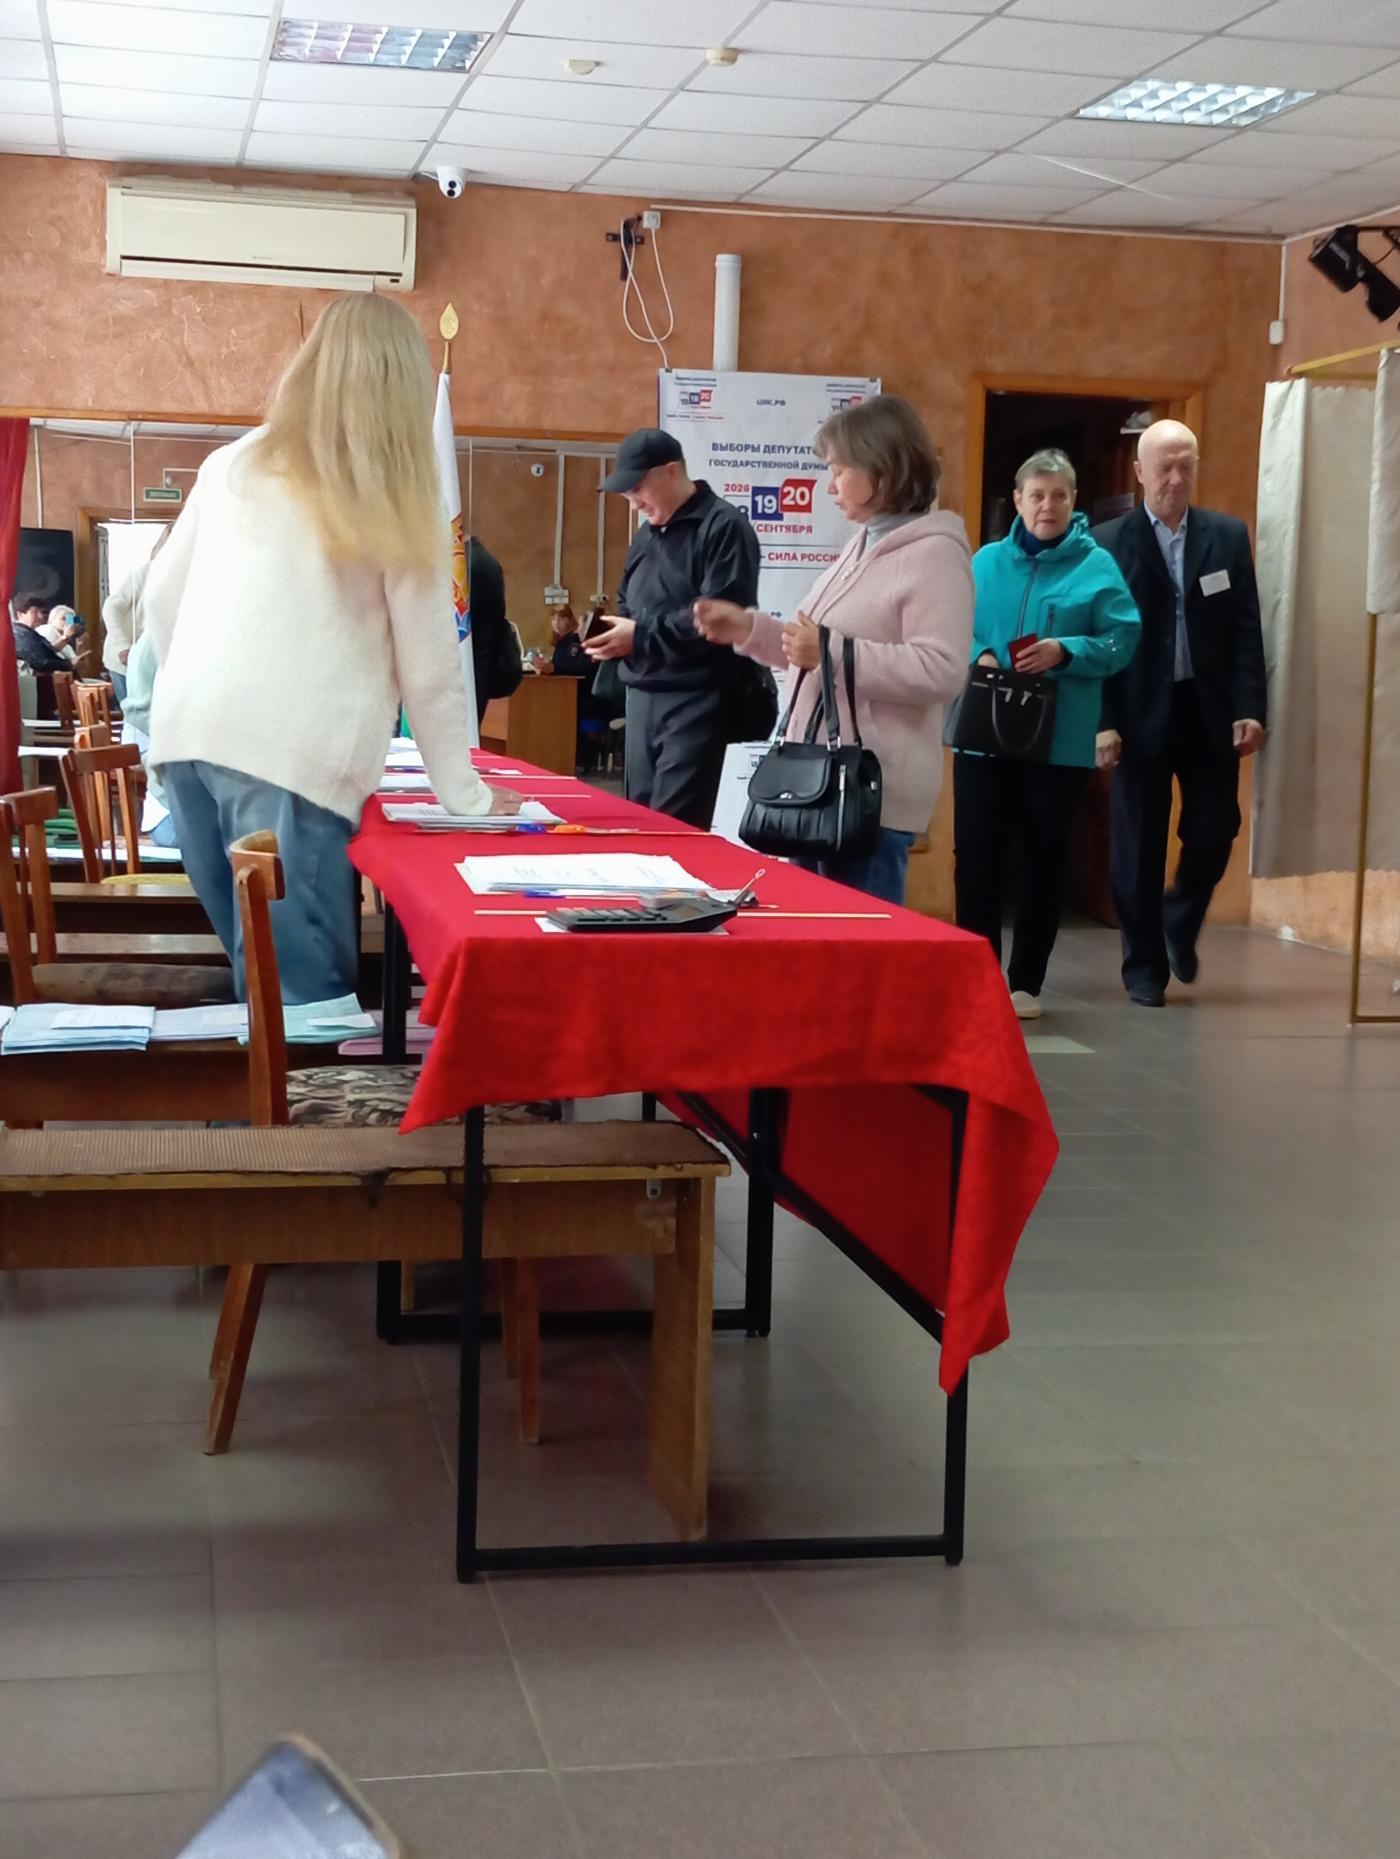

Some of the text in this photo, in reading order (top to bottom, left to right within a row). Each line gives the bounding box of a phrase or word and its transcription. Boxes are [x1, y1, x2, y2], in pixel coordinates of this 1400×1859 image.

[711, 442, 813, 455] ВЫБОРЫ ДЕПУТАТ
[709, 458, 829, 471] ГОСУДАРСТВЕННОЙ ДУМЫ
[724, 483, 750, 493] 2026
[754, 494, 778, 514] 19
[782, 486, 810, 506] 20
[756, 523, 813, 534] СЕНТЯБРЯ
[767, 552, 798, 561] СИЛА
